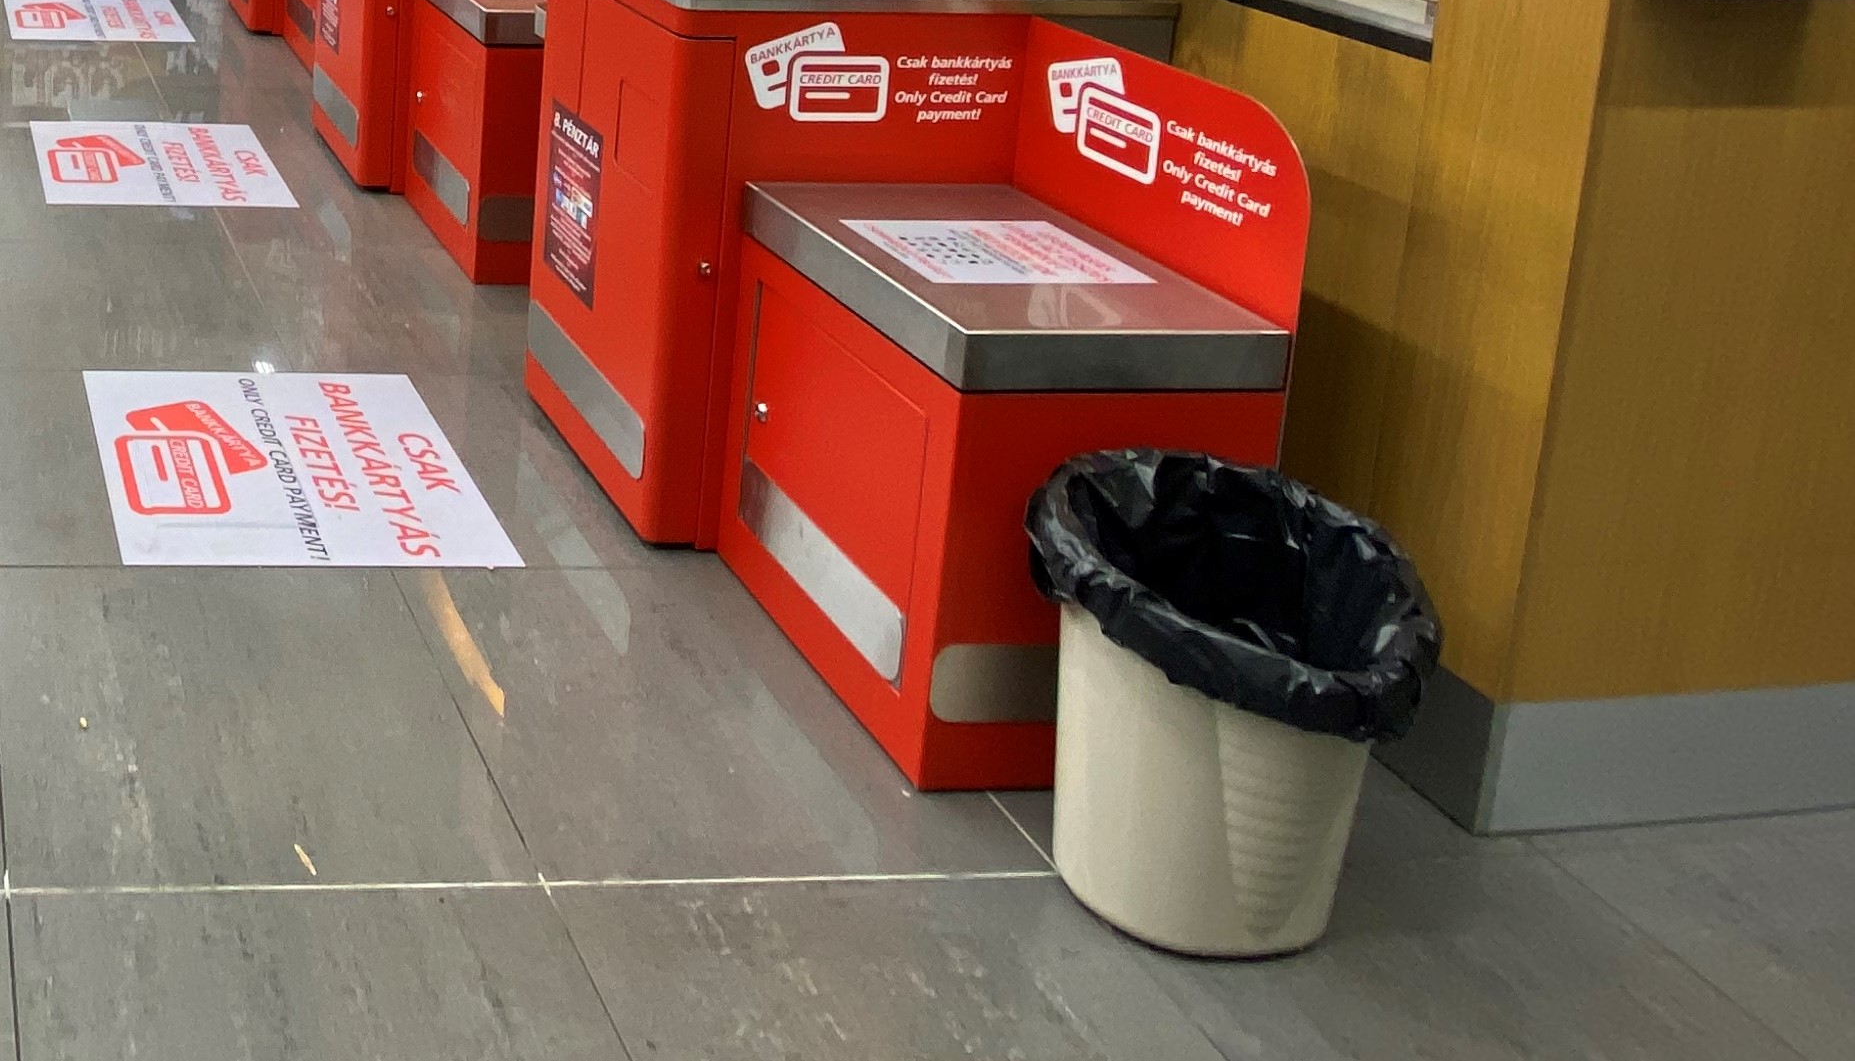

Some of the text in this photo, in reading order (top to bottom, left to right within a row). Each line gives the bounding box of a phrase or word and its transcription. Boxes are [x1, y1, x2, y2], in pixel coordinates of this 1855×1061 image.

[750, 26, 836, 64] BANKKÁRTYA
[897, 55, 1012, 71] Csak bankkártyás
[799, 74, 882, 85] CREDIT CARD
[928, 73, 978, 86] fizetés!
[1051, 63, 1117, 81] BANKKÁRTYA
[894, 91, 1008, 105] Only Credit Card
[917, 108, 981, 123] payment!
[562, 119, 600, 158] PÉNZTÁR
[1086, 106, 1153, 143] CREDIT CARD
[234, 149, 268, 177] CSAK
[1167, 120, 1277, 177] Csak bankkártyás
[1194, 150, 1242, 184] fizetés!
[1163, 159, 1271, 218] Only Credit Card
[1181, 191, 1243, 227] payment!
[186, 401, 260, 469] BANKKÁRTYA
[169, 441, 203, 509] CREDIT CARD
[238, 378, 331, 561] ONLY CREDIT CARD PAYMENT!
[284, 415, 361, 513] FIZETÉS!
[318, 381, 441, 559] BANKKÁRTYÁS
[397, 433, 461, 494] CSAK
